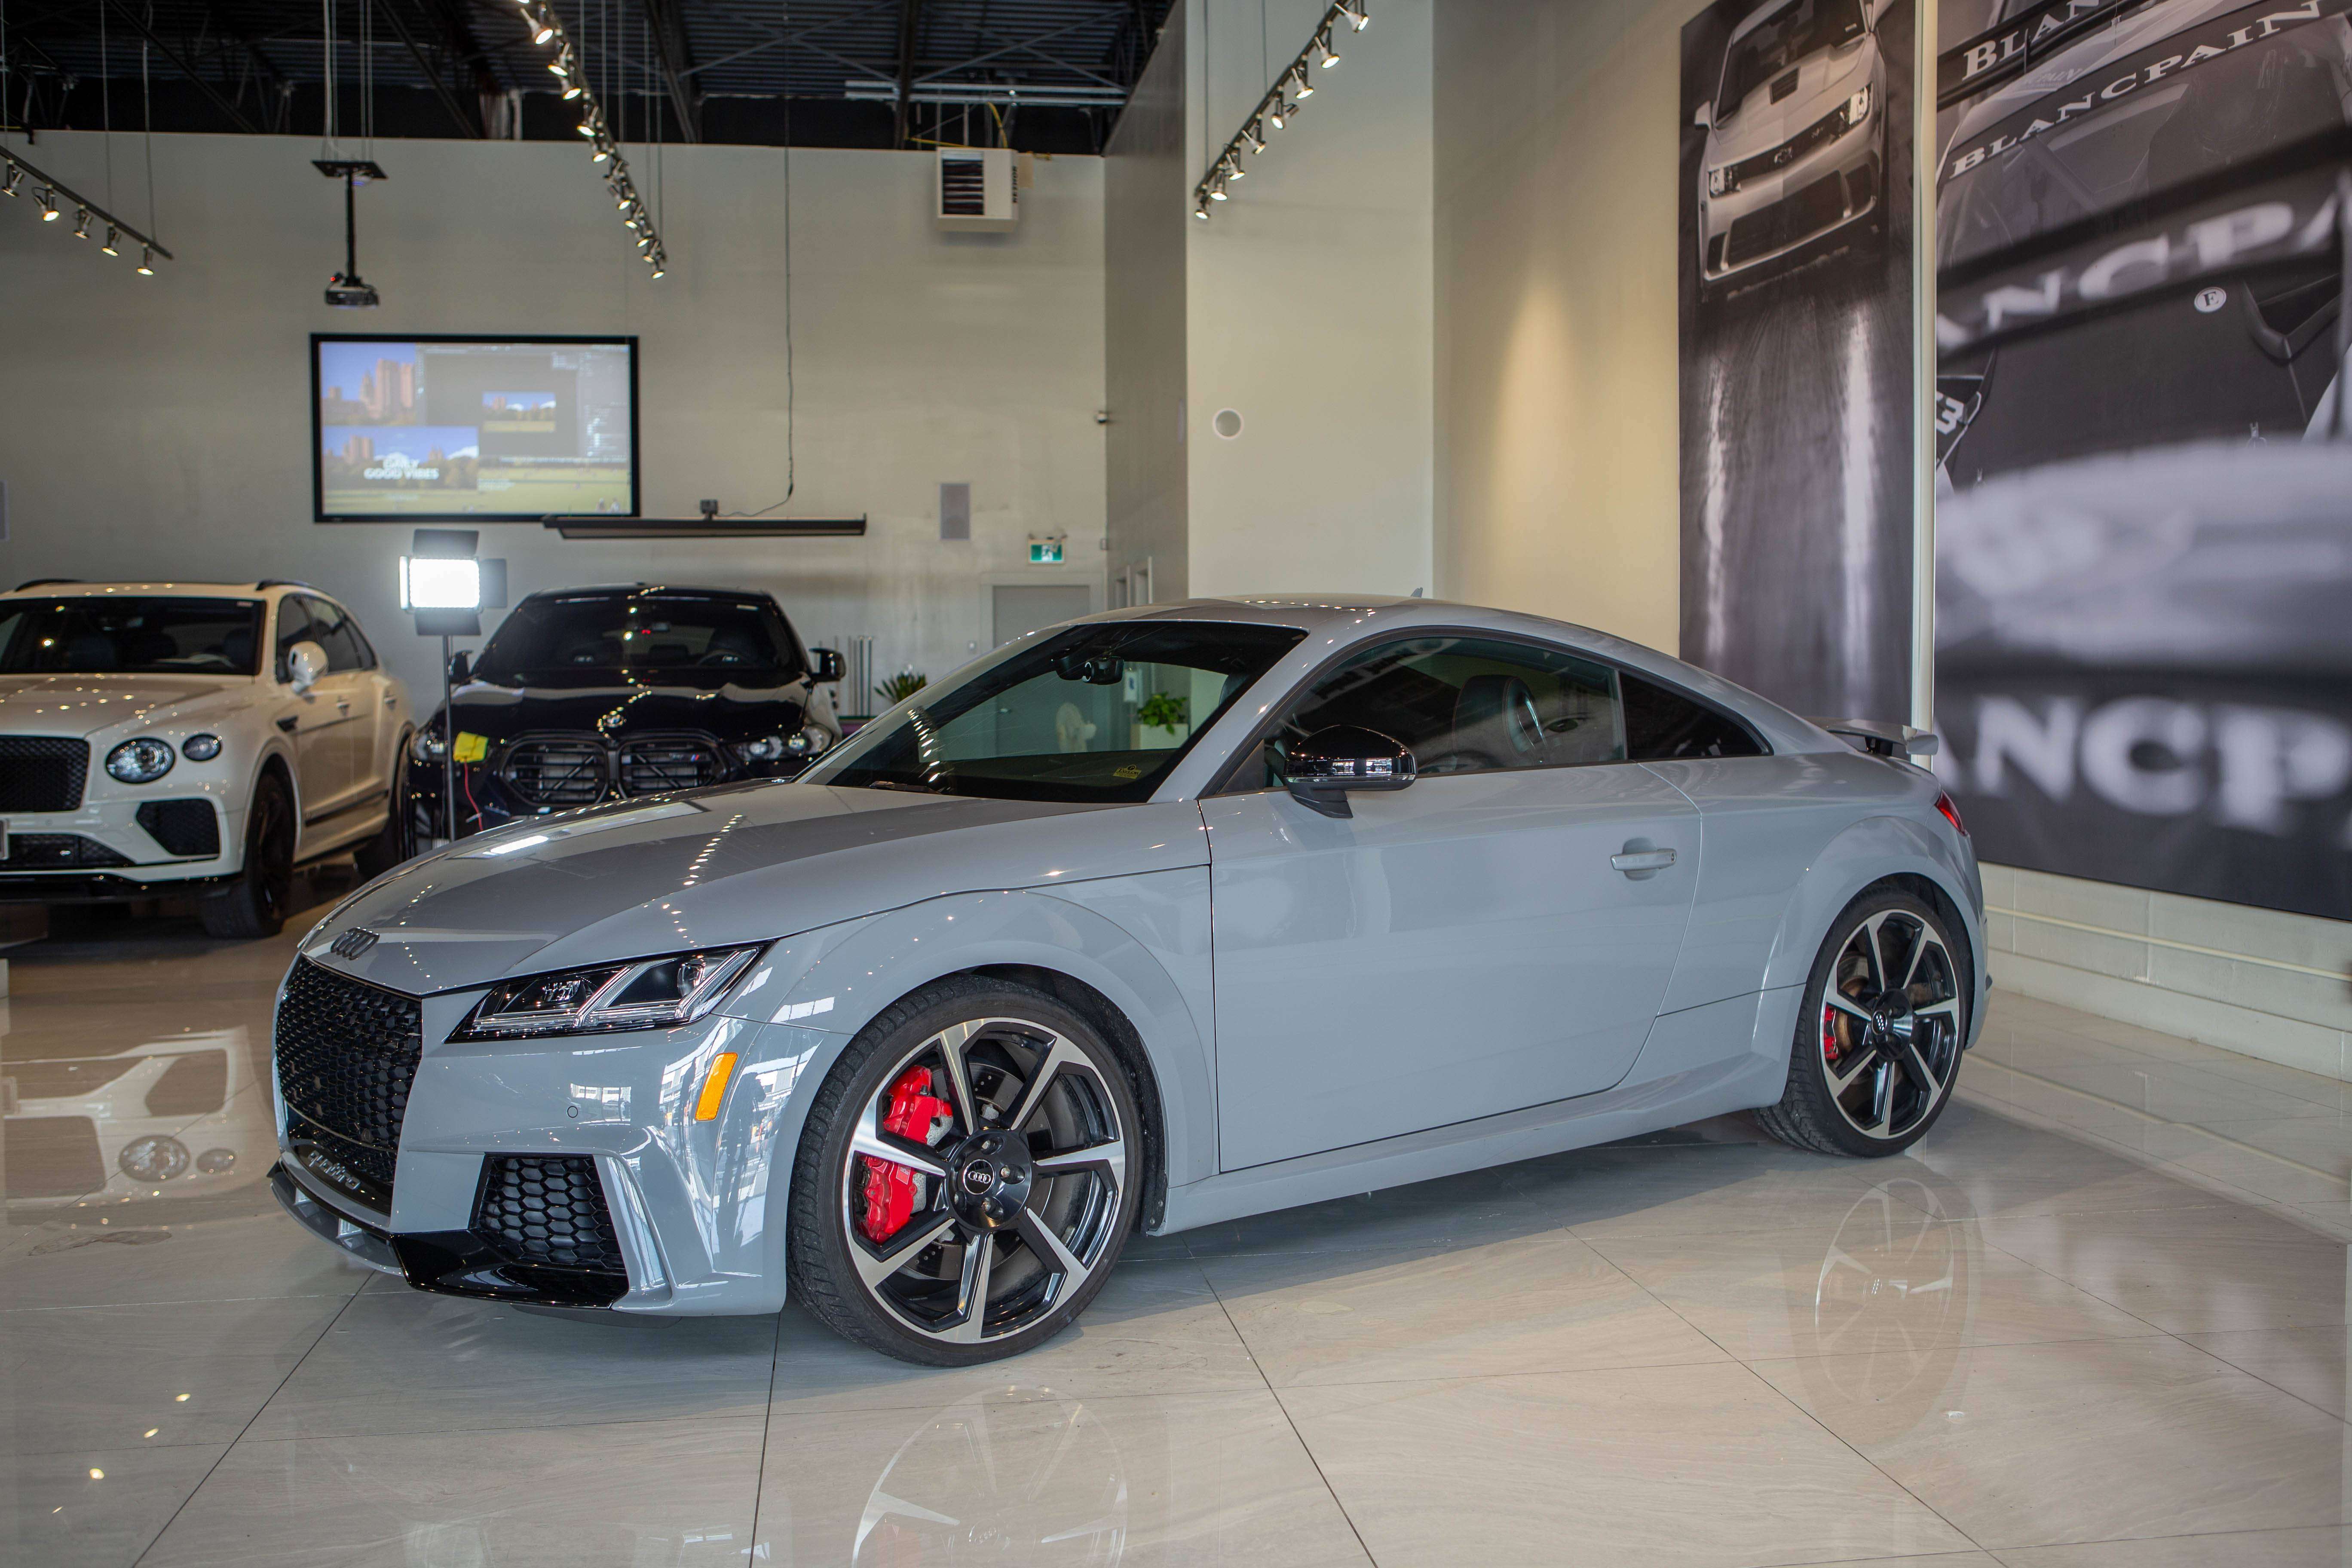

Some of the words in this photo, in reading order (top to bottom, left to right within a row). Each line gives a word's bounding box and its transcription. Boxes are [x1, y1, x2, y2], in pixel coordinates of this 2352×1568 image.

[1949, 0, 2320, 179] BLANCPAIN
[364, 467, 403, 480] GOOD
[404, 467, 440, 480] VIBES
[307, 1150, 361, 1190] quattro
